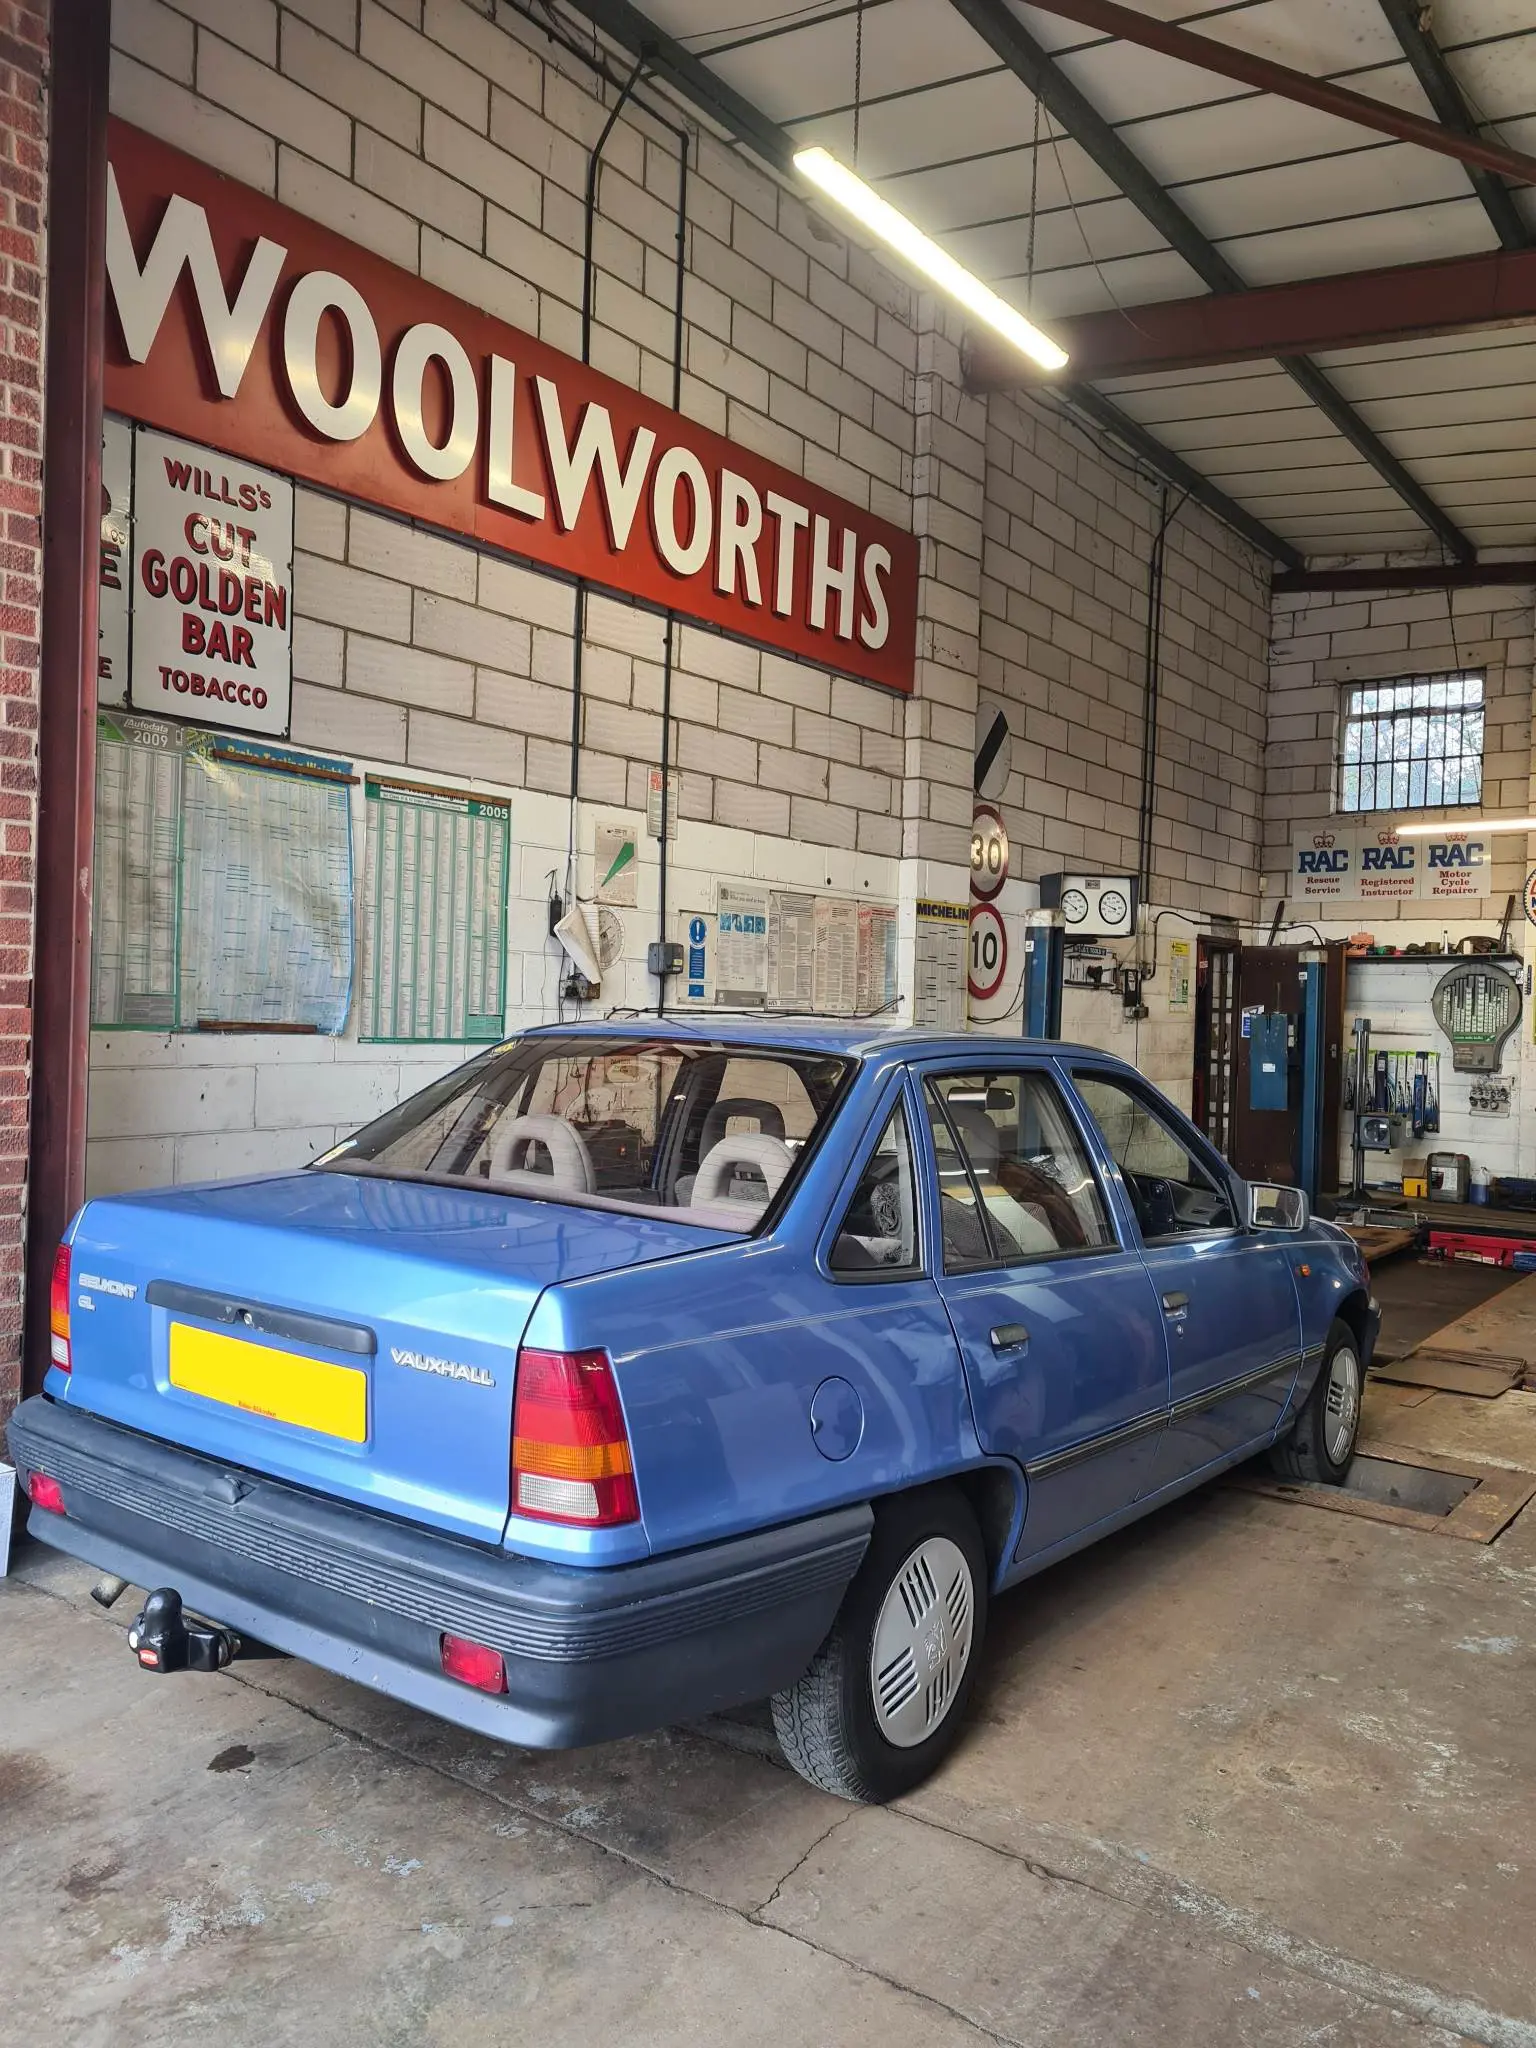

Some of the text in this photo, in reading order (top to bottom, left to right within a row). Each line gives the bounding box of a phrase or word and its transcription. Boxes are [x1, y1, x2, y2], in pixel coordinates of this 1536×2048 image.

[106, 161, 892, 651] WOOLWORTHS
[184, 512, 257, 569] CUT
[142, 549, 287, 631] GOLDEN
[182, 612, 257, 669] BAR
[158, 666, 268, 710] TOBACCO
[133, 730, 169, 748] 2009
[479, 804, 509, 819] 2005
[971, 833, 1001, 875] 30
[1298, 849, 1349, 873] RAC
[1361, 845, 1415, 870] RAC
[1427, 842, 1485, 867] RAC
[1306, 876, 1340, 884] Rescue
[1360, 877, 1415, 887] Registered
[1439, 870, 1472, 879] Motor
[1441, 878, 1470, 887] Cycle
[1304, 886, 1341, 894] Service
[1360, 887, 1414, 896] Instructor
[1432, 886, 1479, 895] Repairer
[916, 902, 969, 921] MICHELIN
[972, 930, 998, 970] 10
[390, 1346, 496, 1388] VAUXHALL
